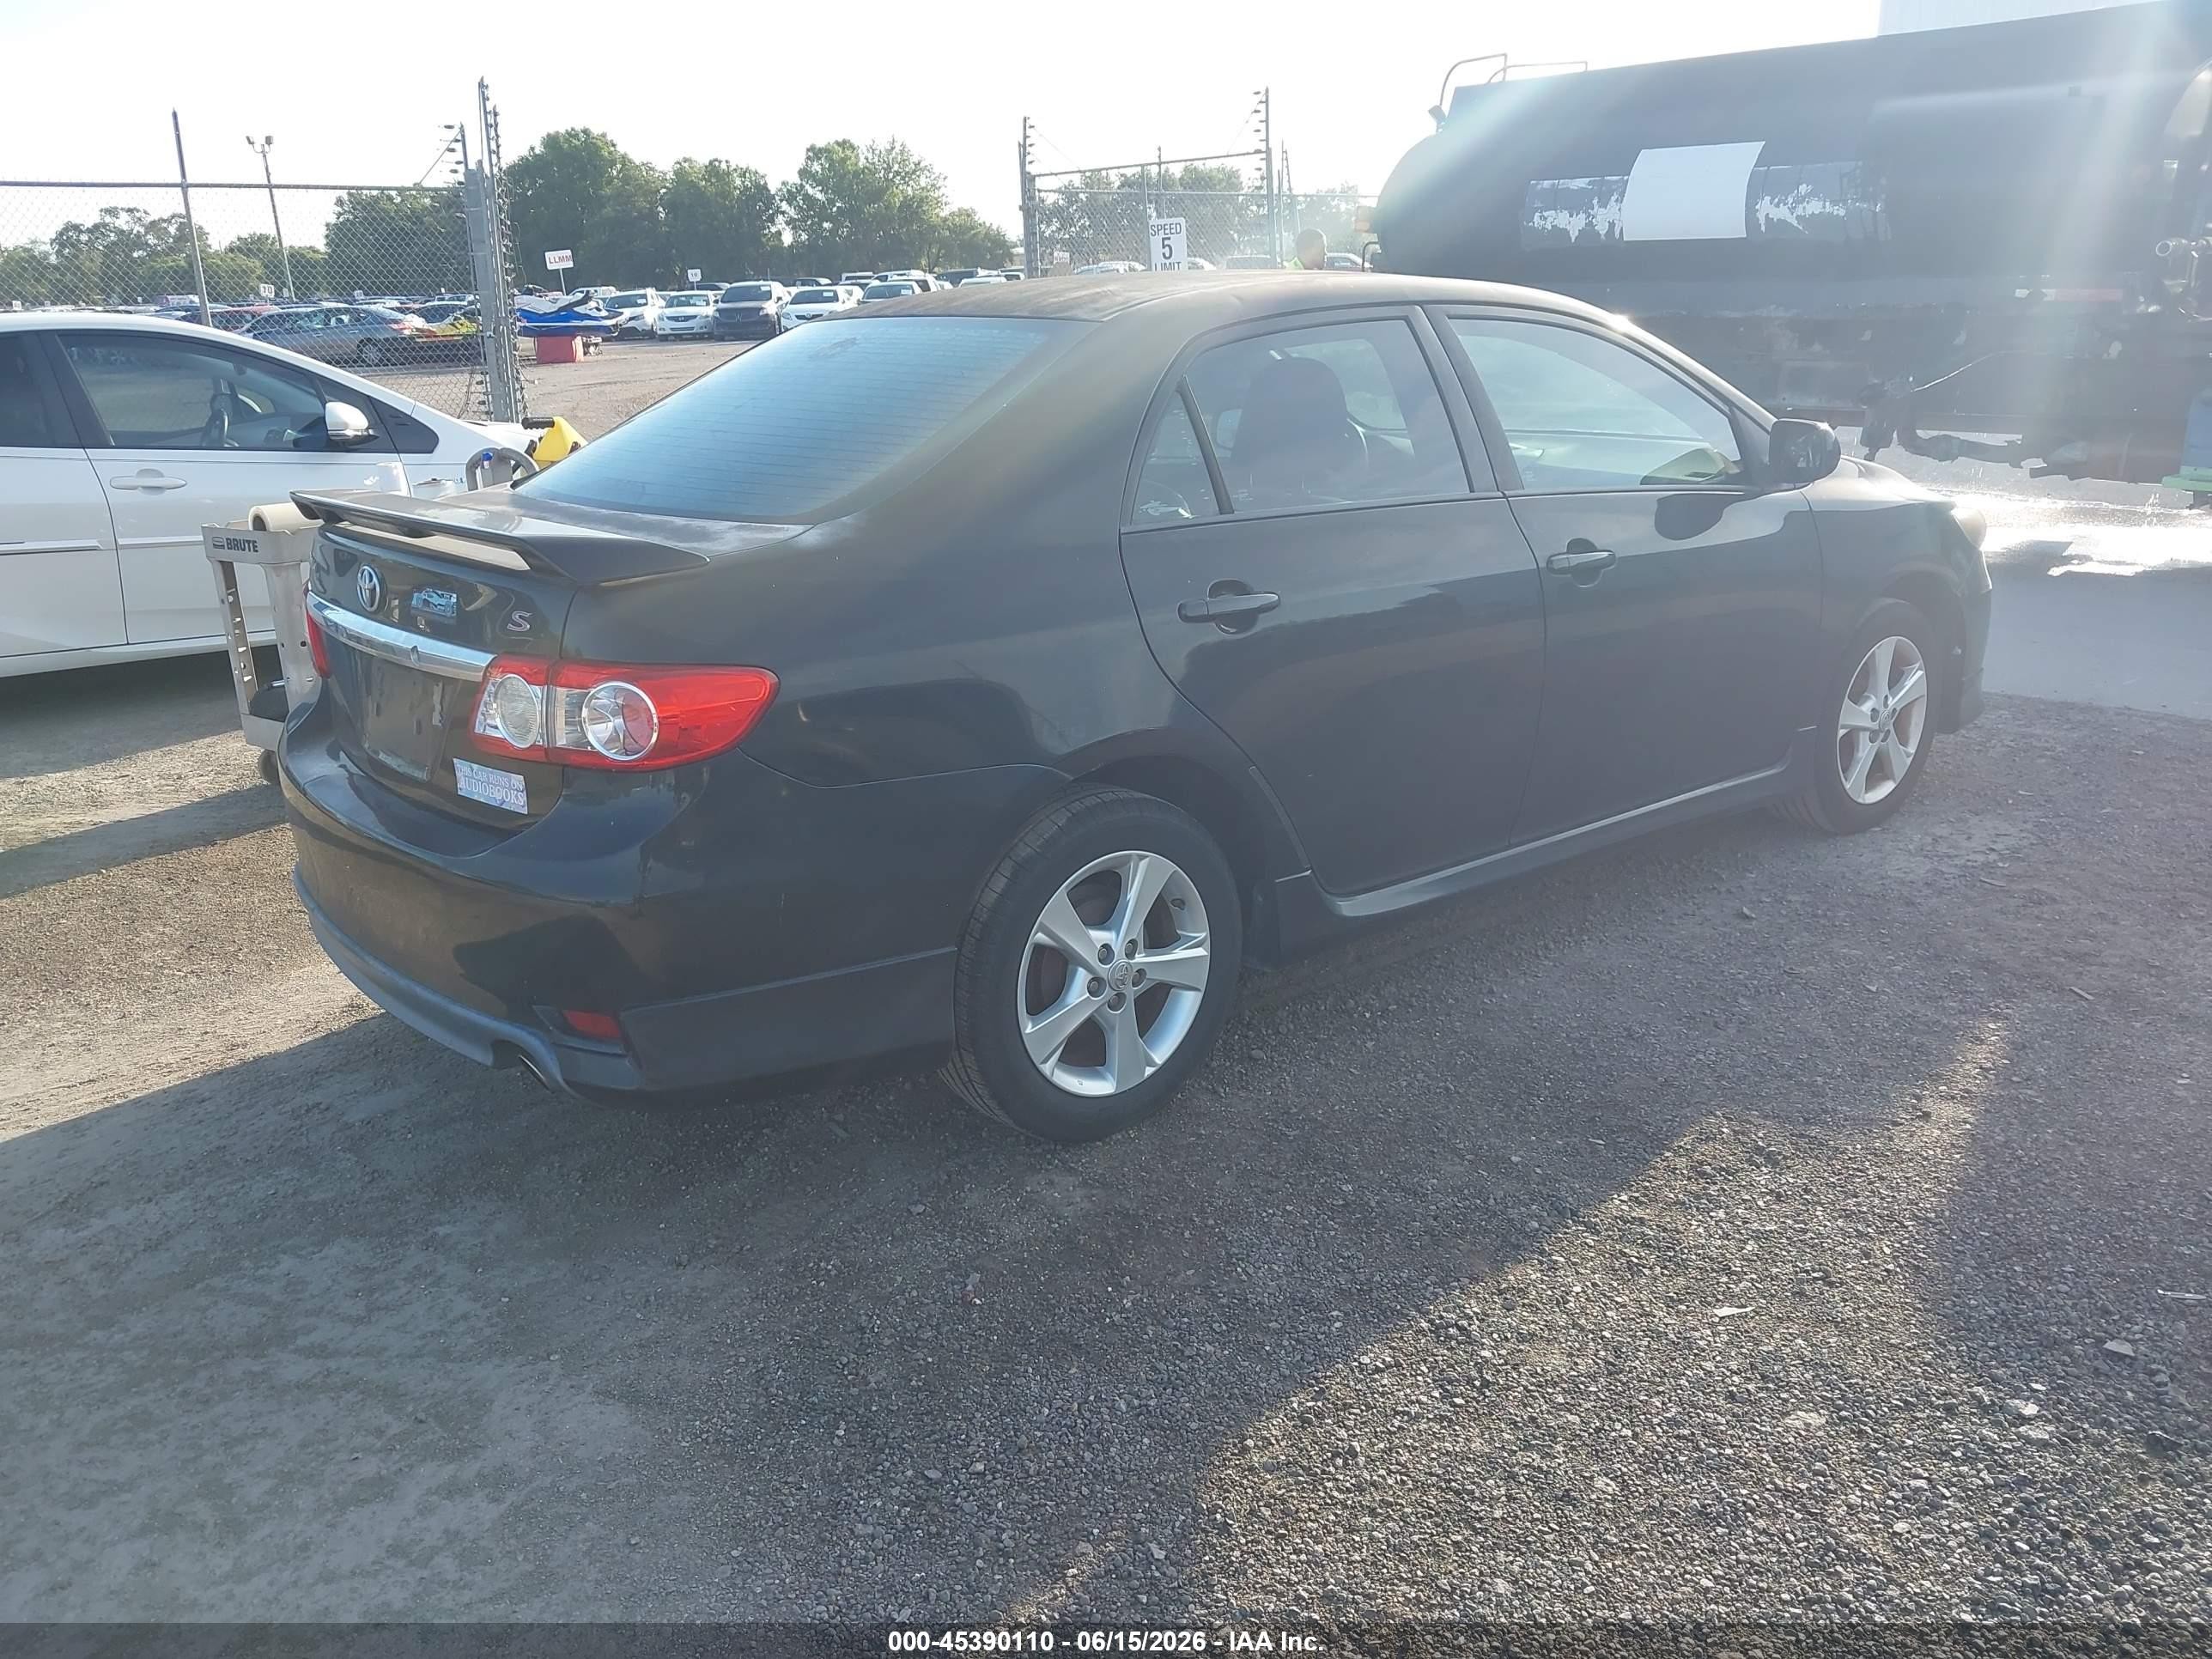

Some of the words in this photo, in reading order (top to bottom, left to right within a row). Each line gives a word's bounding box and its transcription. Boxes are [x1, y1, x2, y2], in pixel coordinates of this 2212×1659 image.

[1151, 222, 1182, 236] SPEED
[1161, 236, 1173, 260] 5
[225, 538, 258, 553] BRUTE
[507, 611, 532, 632] S
[457, 764, 472, 777] THIS
[473, 769, 488, 781] CAR
[489, 774, 509, 787] RUNS
[511, 780, 523, 792] ON
[459, 777, 525, 805] AUDIOBOOKS
